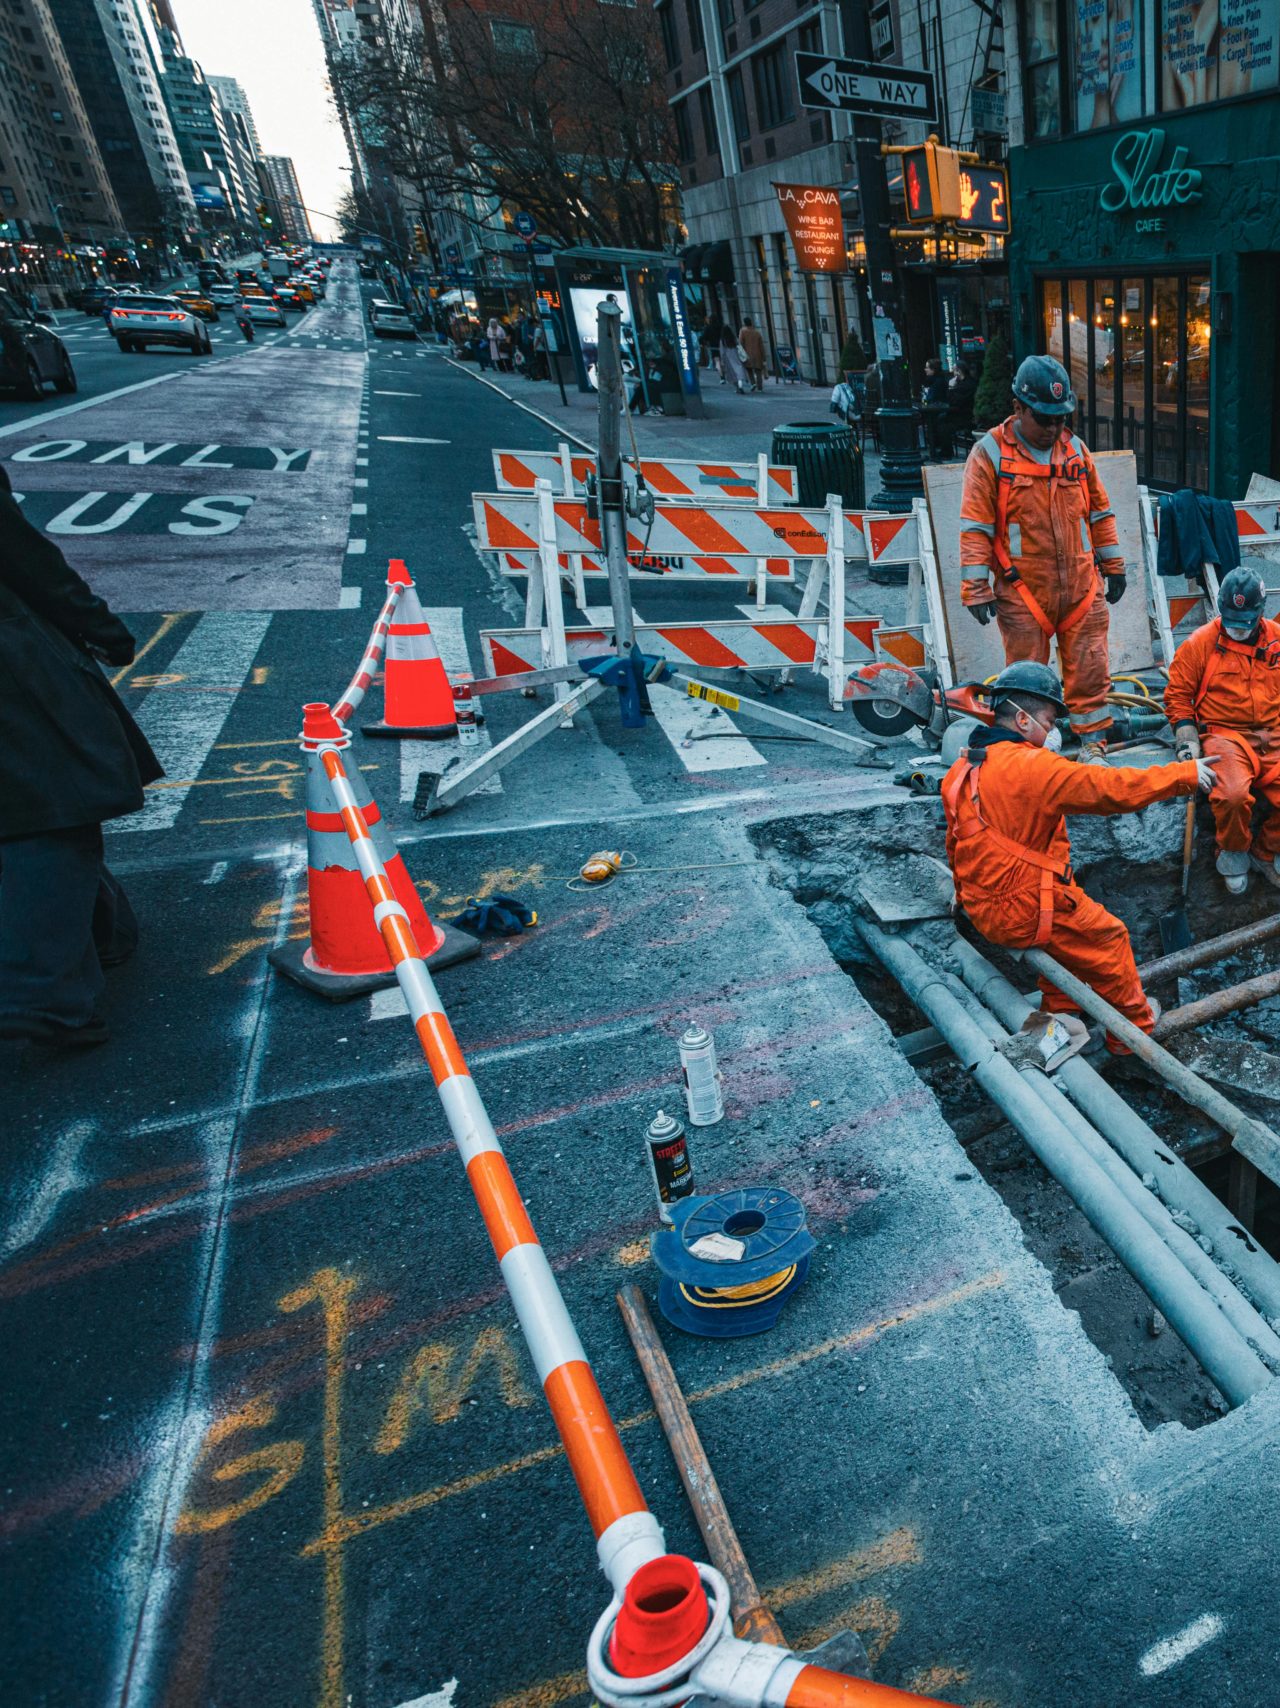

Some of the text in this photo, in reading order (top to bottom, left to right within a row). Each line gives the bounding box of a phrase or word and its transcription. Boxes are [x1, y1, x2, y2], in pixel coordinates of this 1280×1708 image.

[1227, 7, 1261, 27] Knee Pain
[1227, 25, 1259, 44] Foot Pain
[1227, 36, 1272, 61] Carpal Tunnel
[1241, 55, 1271, 73] Syndrome
[820, 72, 918, 105] ONE WAY
[1100, 127, 1203, 212] Slate
[778, 188, 839, 206] LA CAVA
[990, 181, 1004, 222] 2
[798, 215, 834, 226] WINE BAR
[1135, 218, 1163, 233] CAFE
[795, 230, 839, 241] RESTAURANT
[804, 245, 835, 255] LOUNGE
[670, 285, 680, 313] Avenue
[676, 320, 686, 337] East
[679, 338, 687, 348] 50
[681, 348, 691, 371] Street
[11, 439, 312, 472] ONLY
[11, 491, 255, 536] US
[787, 530, 827, 538] conEdison
